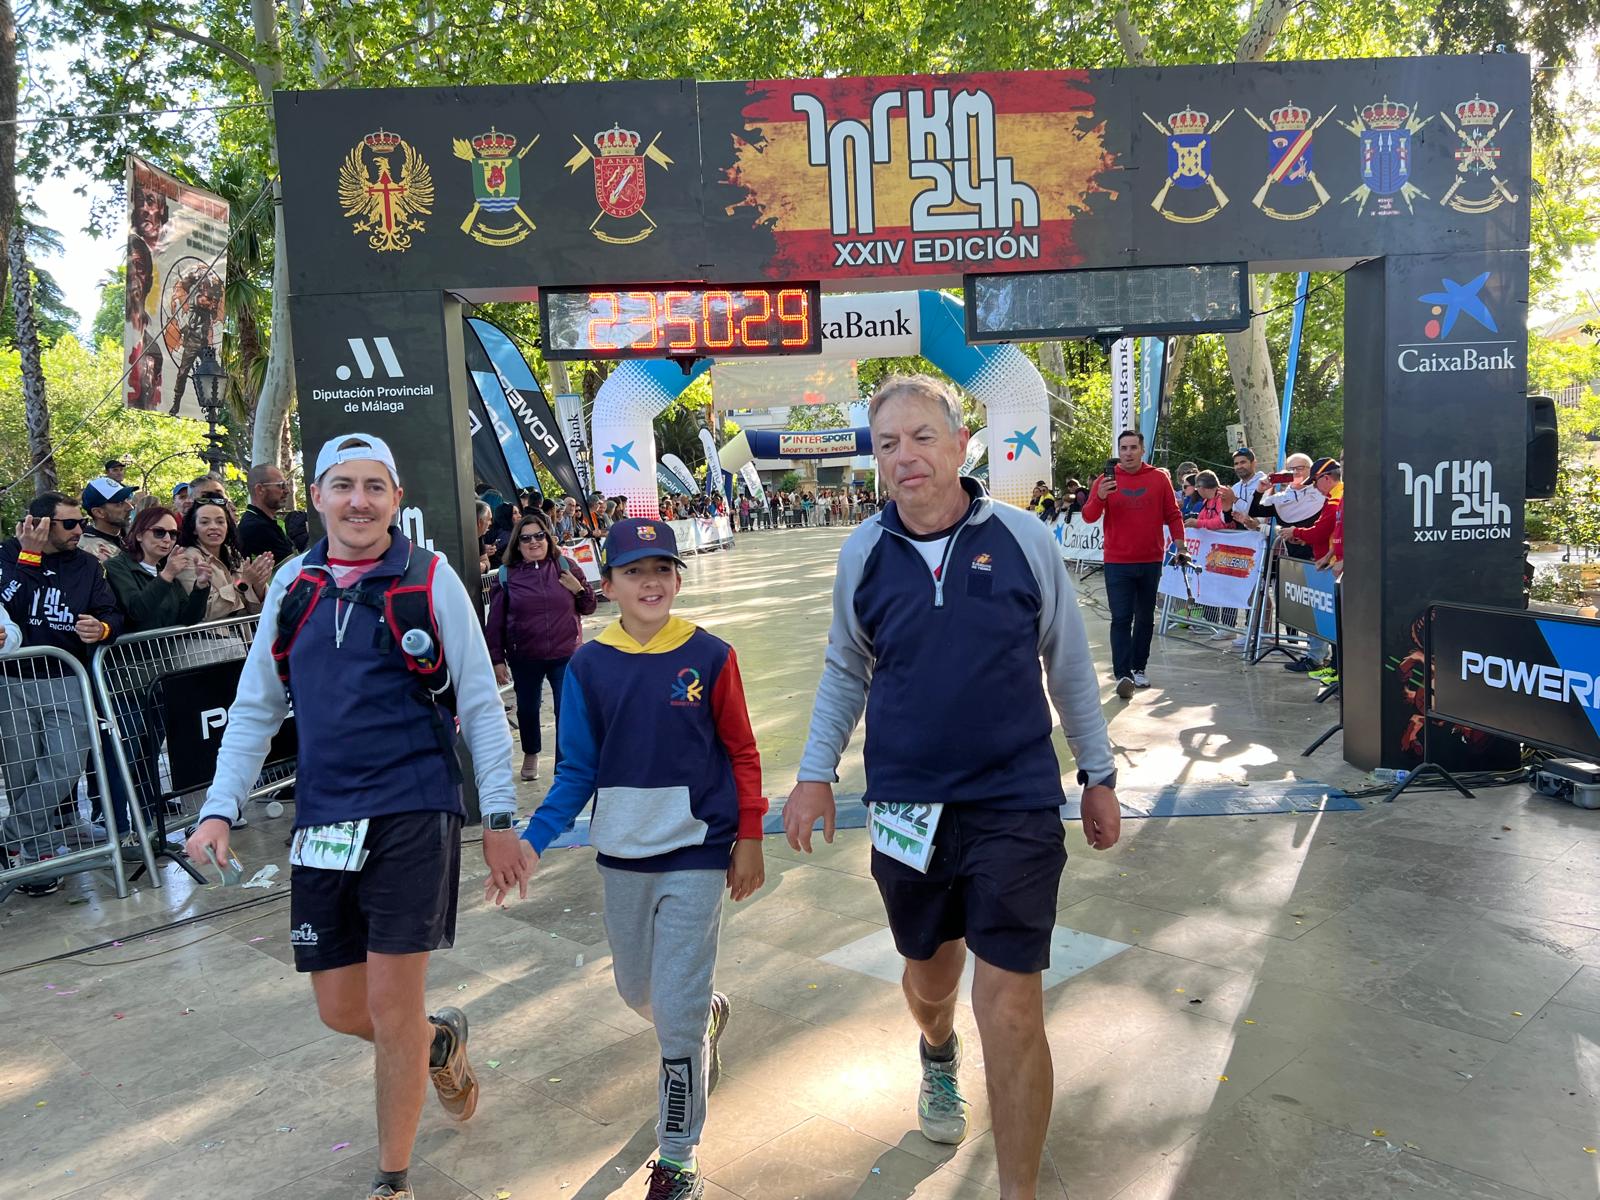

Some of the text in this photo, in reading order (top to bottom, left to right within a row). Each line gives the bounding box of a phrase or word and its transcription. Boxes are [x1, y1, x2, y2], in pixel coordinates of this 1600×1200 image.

[834, 230, 1039, 266] XXIV EDICIÓN
[588, 288, 809, 350] 23:50:29
[1397, 347, 1517, 373] CaixaBank
[313, 384, 434, 402] Diputación Provincial
[344, 400, 404, 413] de Málaga
[792, 433, 853, 444] INTERSPORT
[1413, 525, 1511, 542] XXIV EDICIÓN
[1284, 581, 1334, 614] POWERADE
[665, 1079, 687, 1133] PUMA
